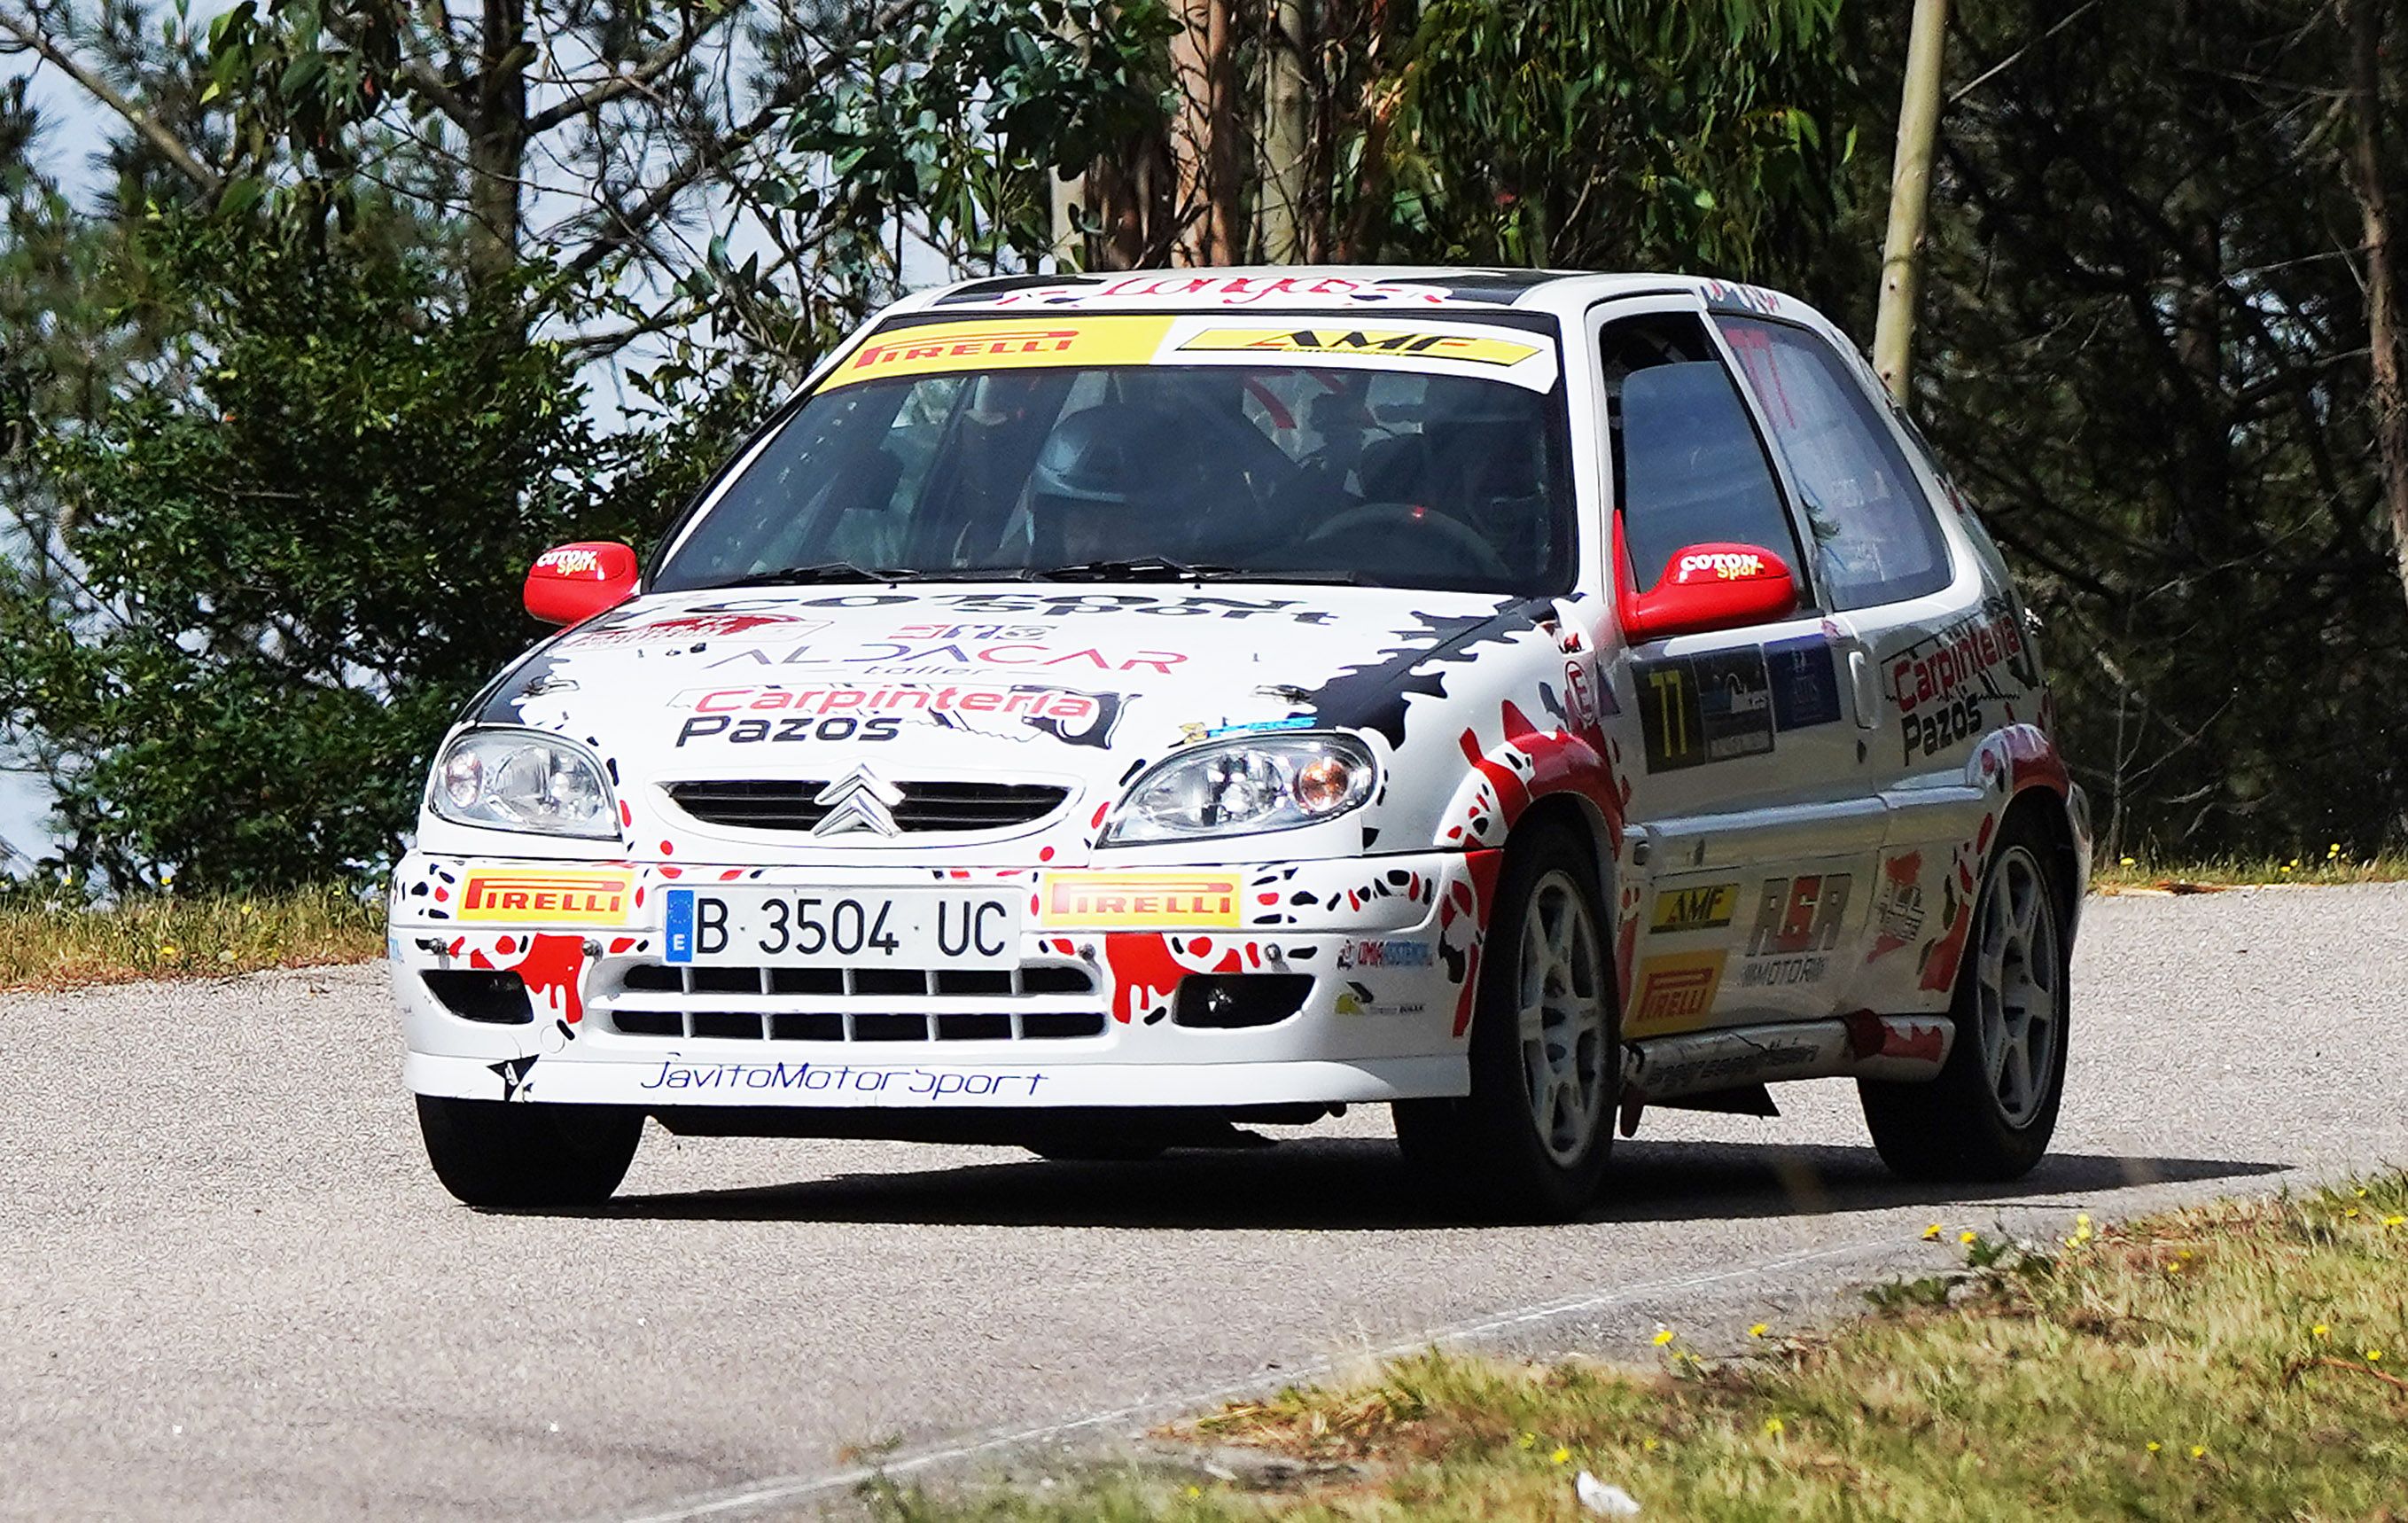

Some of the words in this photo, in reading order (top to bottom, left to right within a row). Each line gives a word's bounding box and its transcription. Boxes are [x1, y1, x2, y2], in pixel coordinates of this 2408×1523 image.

[853, 331, 1079, 369] PIRELLI
[1245, 330, 1478, 351] AMF
[1679, 554, 1758, 571] COTON
[683, 594, 1307, 613] COTON
[954, 601, 1339, 626] Sport
[1648, 669, 1687, 758] 77
[1901, 691, 1983, 767] Pazos
[675, 715, 905, 748] Pazos
[464, 877, 626, 912] PIRELLI
[1051, 882, 1234, 914] PIRELLI
[1665, 886, 1724, 925] AMF
[673, 933, 685, 952] E
[697, 898, 729, 955] B
[759, 898, 900, 956] 3504
[938, 900, 1007, 957] UC
[1638, 967, 1714, 1021] PIRELLI
